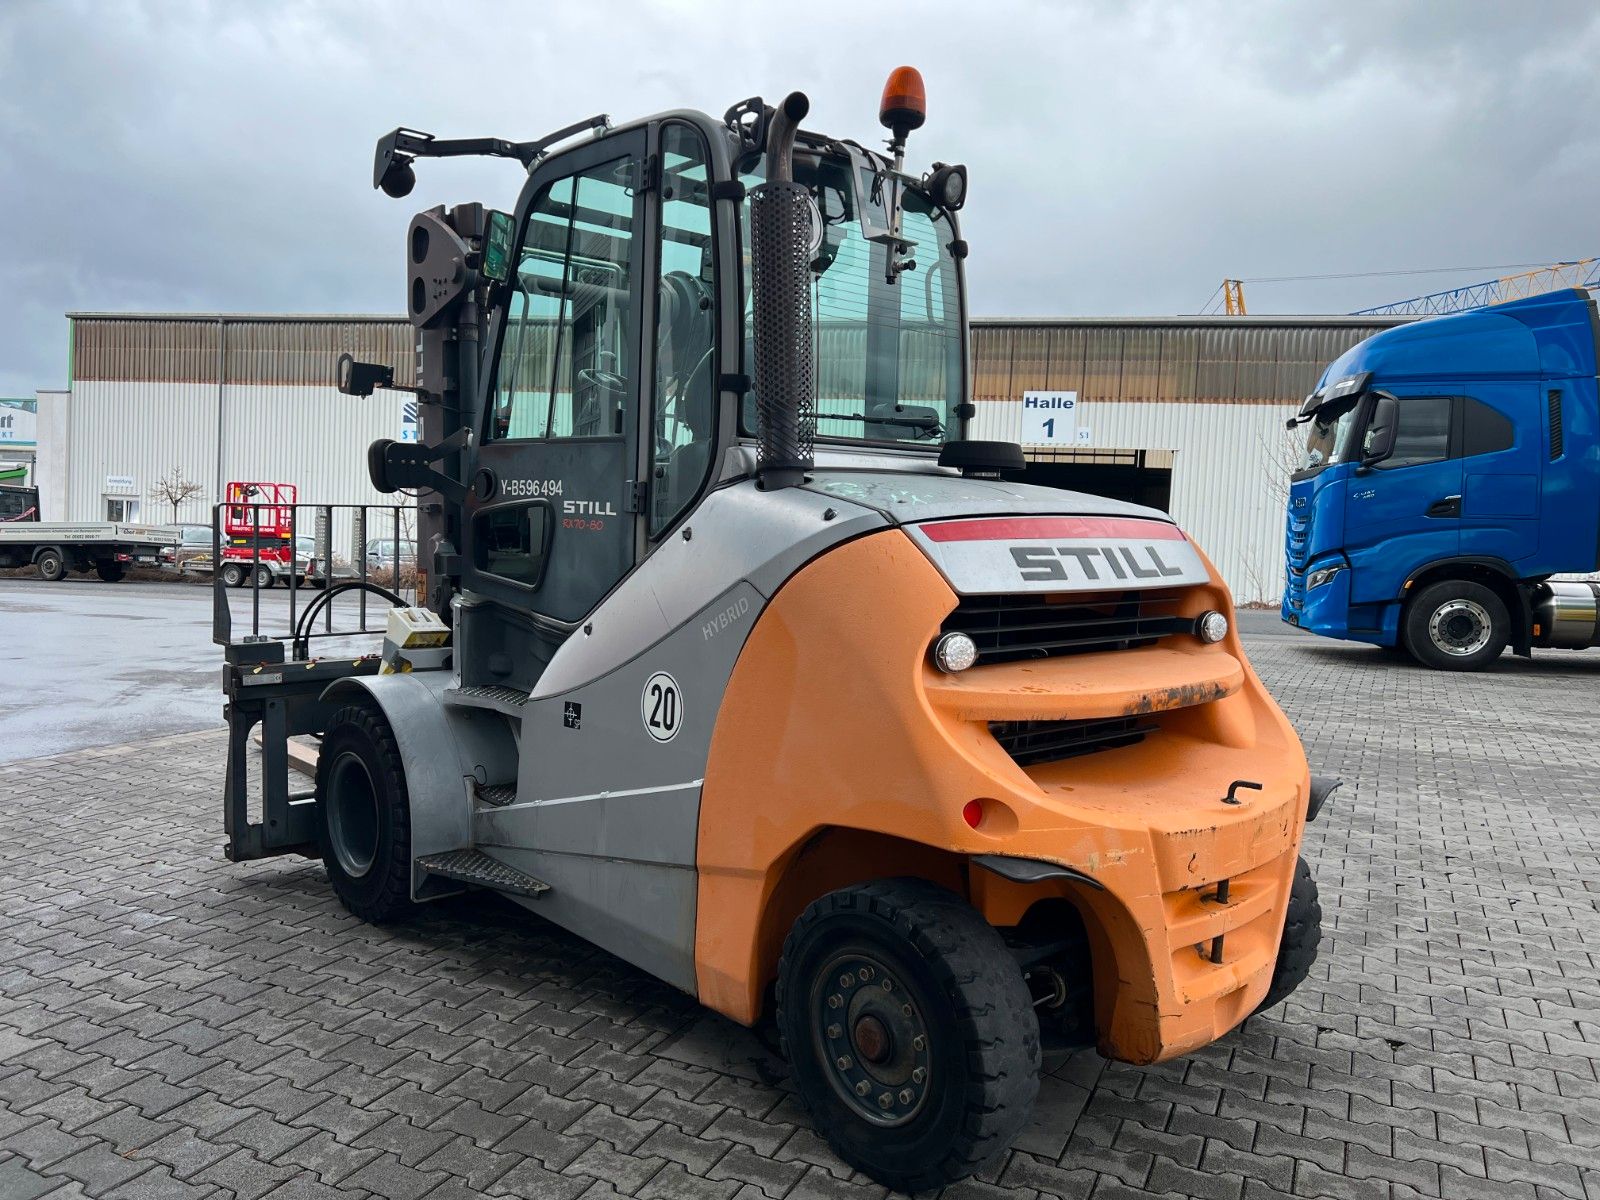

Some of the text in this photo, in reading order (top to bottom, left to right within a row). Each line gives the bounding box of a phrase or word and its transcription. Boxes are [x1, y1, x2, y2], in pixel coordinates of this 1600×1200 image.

[1025, 397, 1074, 409] Halle
[1042, 418, 1055, 438] 1
[563, 500, 617, 516] STILL
[1009, 545, 1184, 582] STILL
[702, 596, 749, 641] HYBRID
[649, 683, 676, 731] 20
